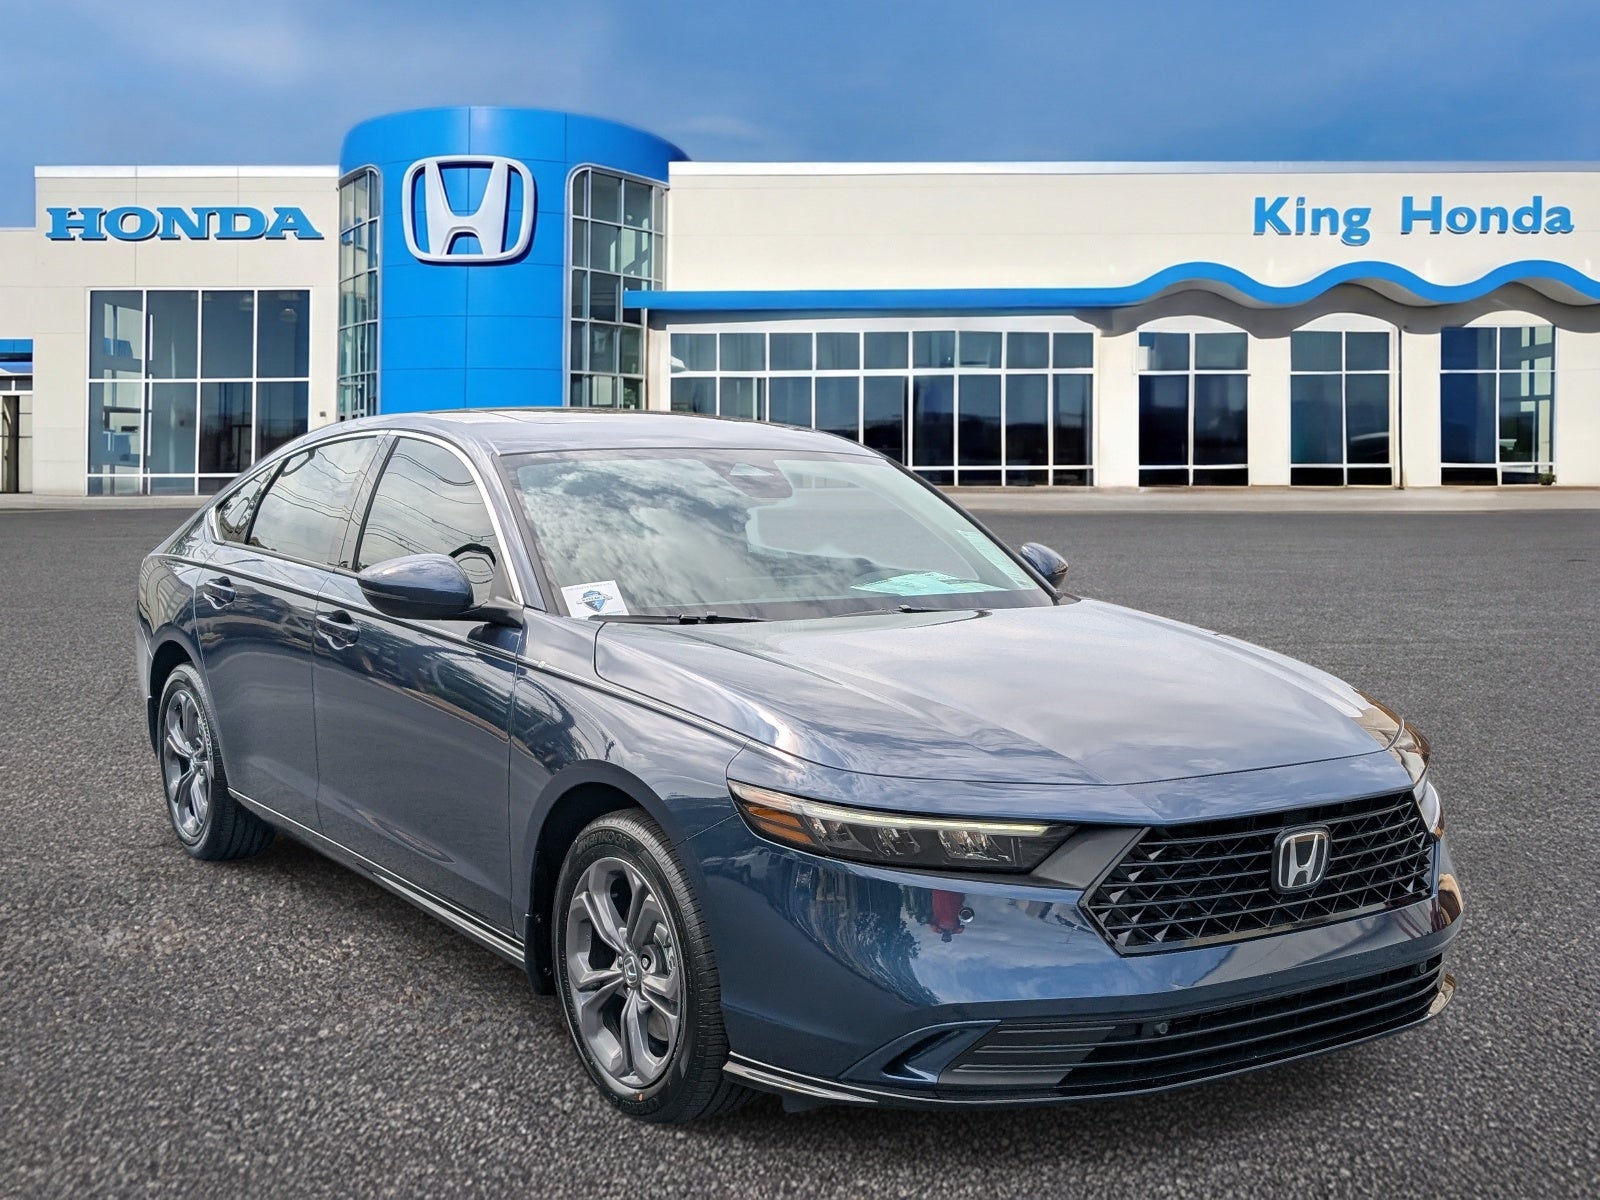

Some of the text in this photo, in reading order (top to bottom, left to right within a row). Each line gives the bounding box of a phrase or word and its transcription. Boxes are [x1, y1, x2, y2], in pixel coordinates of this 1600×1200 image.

[45, 206, 324, 241] HONDA
[1253, 195, 1574, 246] King Honda
